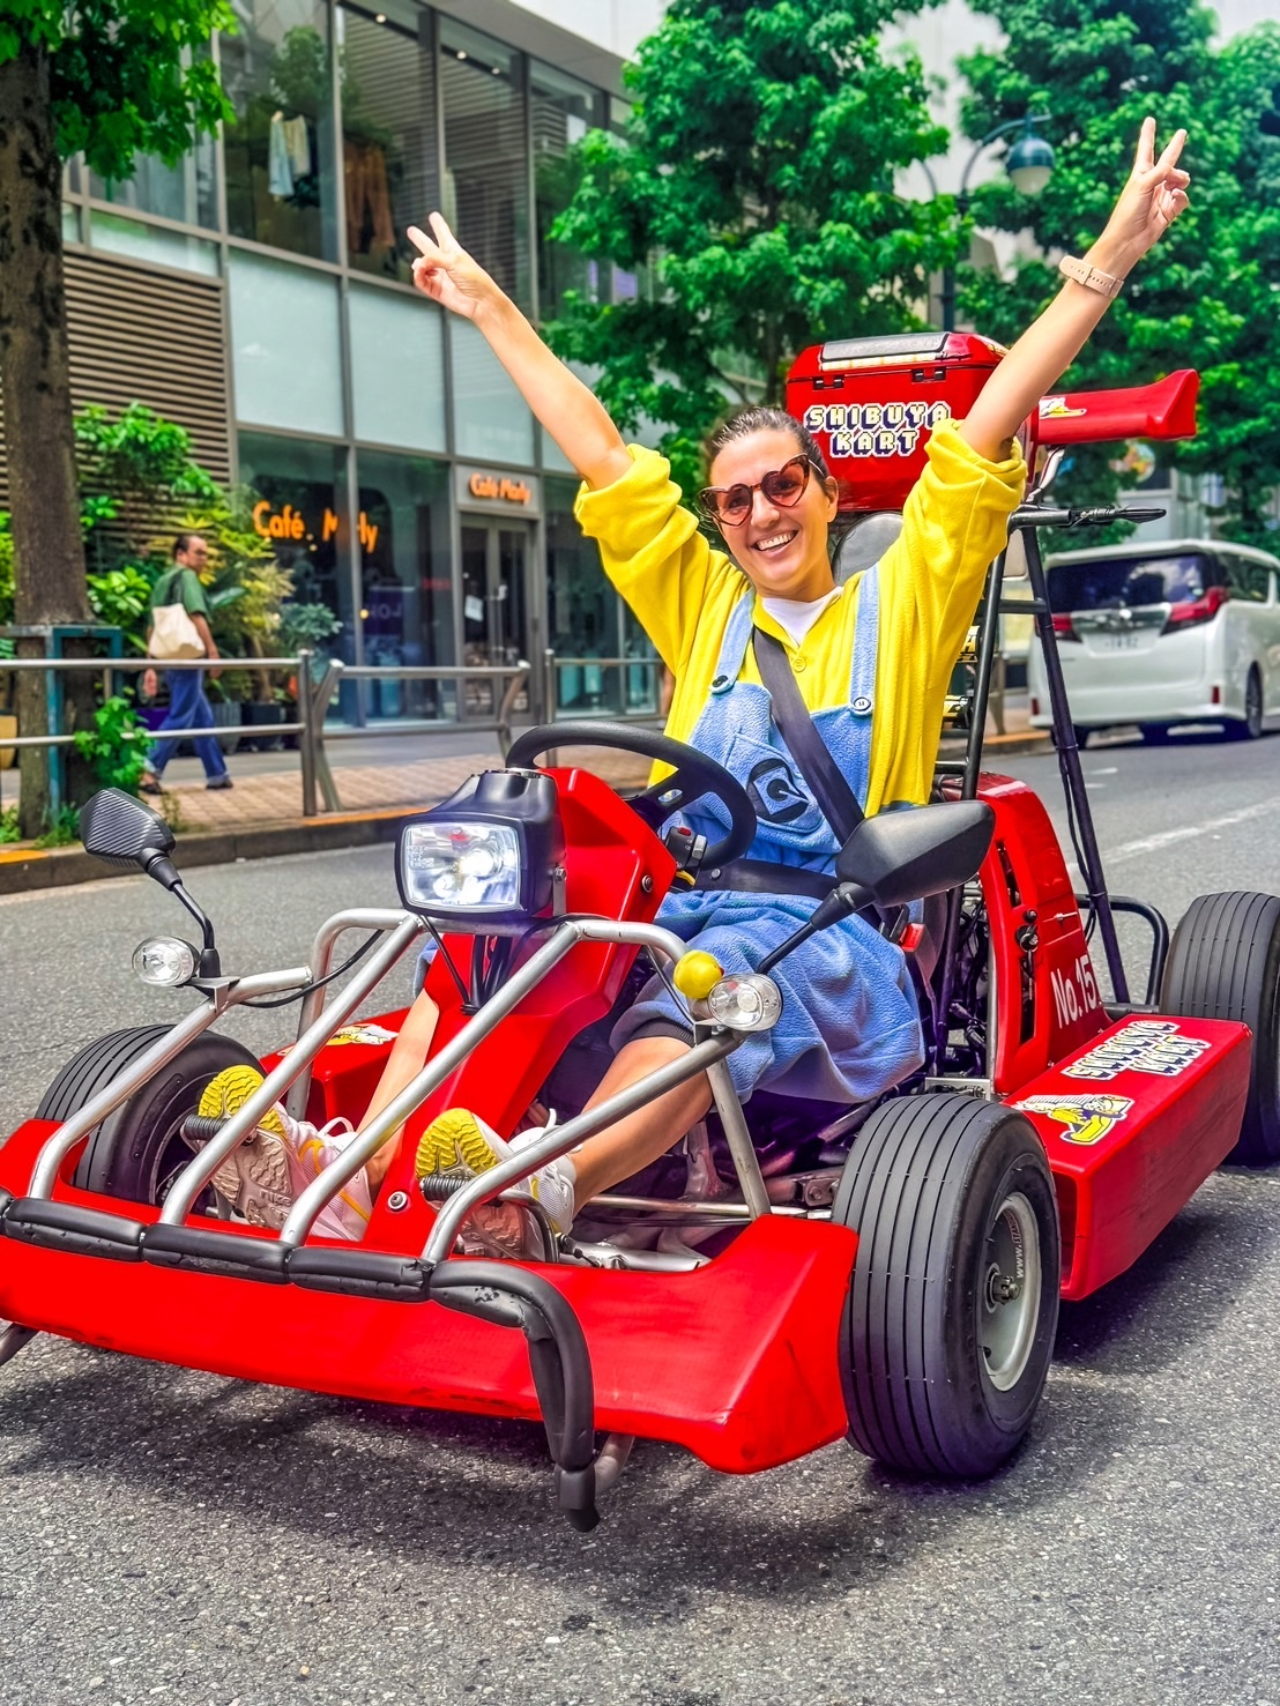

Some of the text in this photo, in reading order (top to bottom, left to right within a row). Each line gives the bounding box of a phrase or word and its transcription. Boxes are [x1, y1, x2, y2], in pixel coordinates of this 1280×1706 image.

[804, 401, 951, 432] SHIBUYA
[830, 430, 919, 457] KART
[252, 500, 305, 539] Café
[1051, 954, 1097, 1029] No.15
[1060, 1020, 1181, 1080] SHIBUYA
[1126, 1034, 1212, 1076] KART
